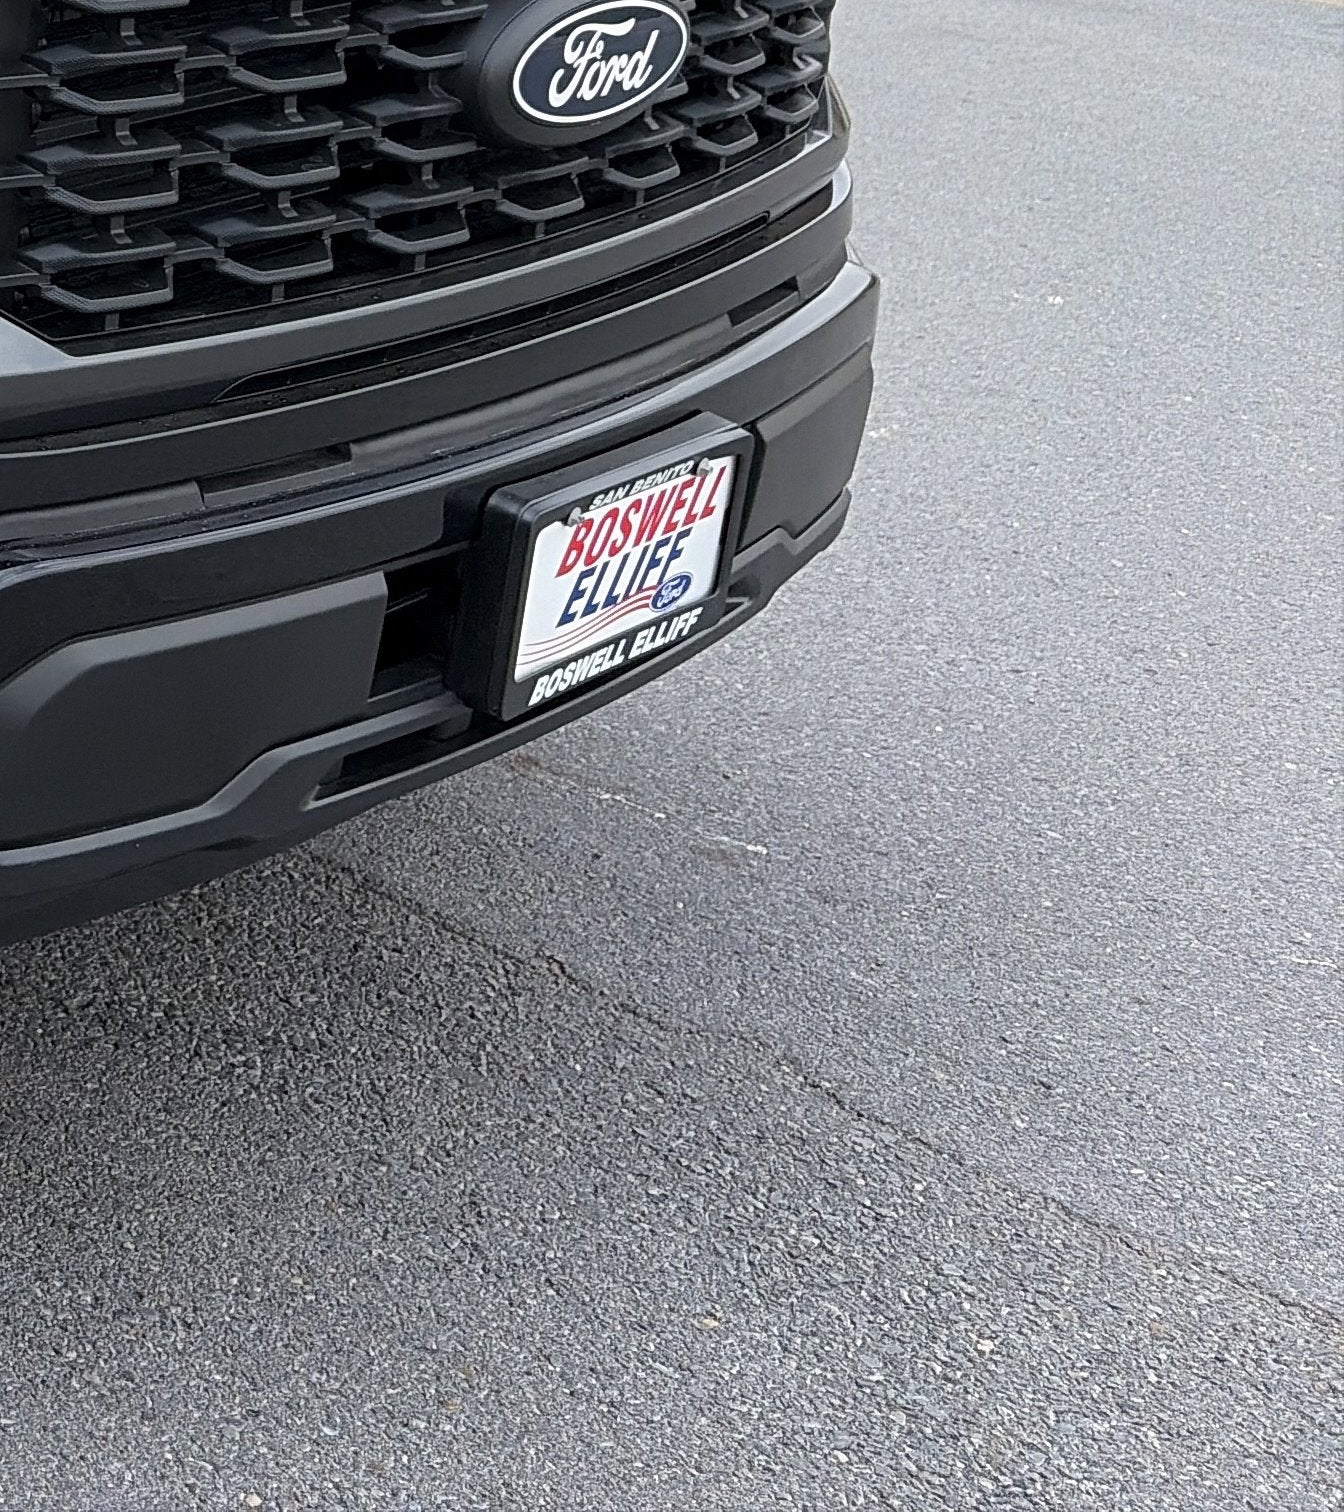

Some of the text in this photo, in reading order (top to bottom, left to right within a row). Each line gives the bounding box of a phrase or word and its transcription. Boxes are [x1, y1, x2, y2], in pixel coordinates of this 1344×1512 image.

[548, 17, 660, 108] Ford
[553, 465, 728, 579] BOSWELL
[588, 459, 695, 511] SAN BENITO
[554, 527, 695, 630] ELLIFF
[656, 577, 687, 608] Ford
[527, 606, 704, 708] BOSWELL ELLIFF
